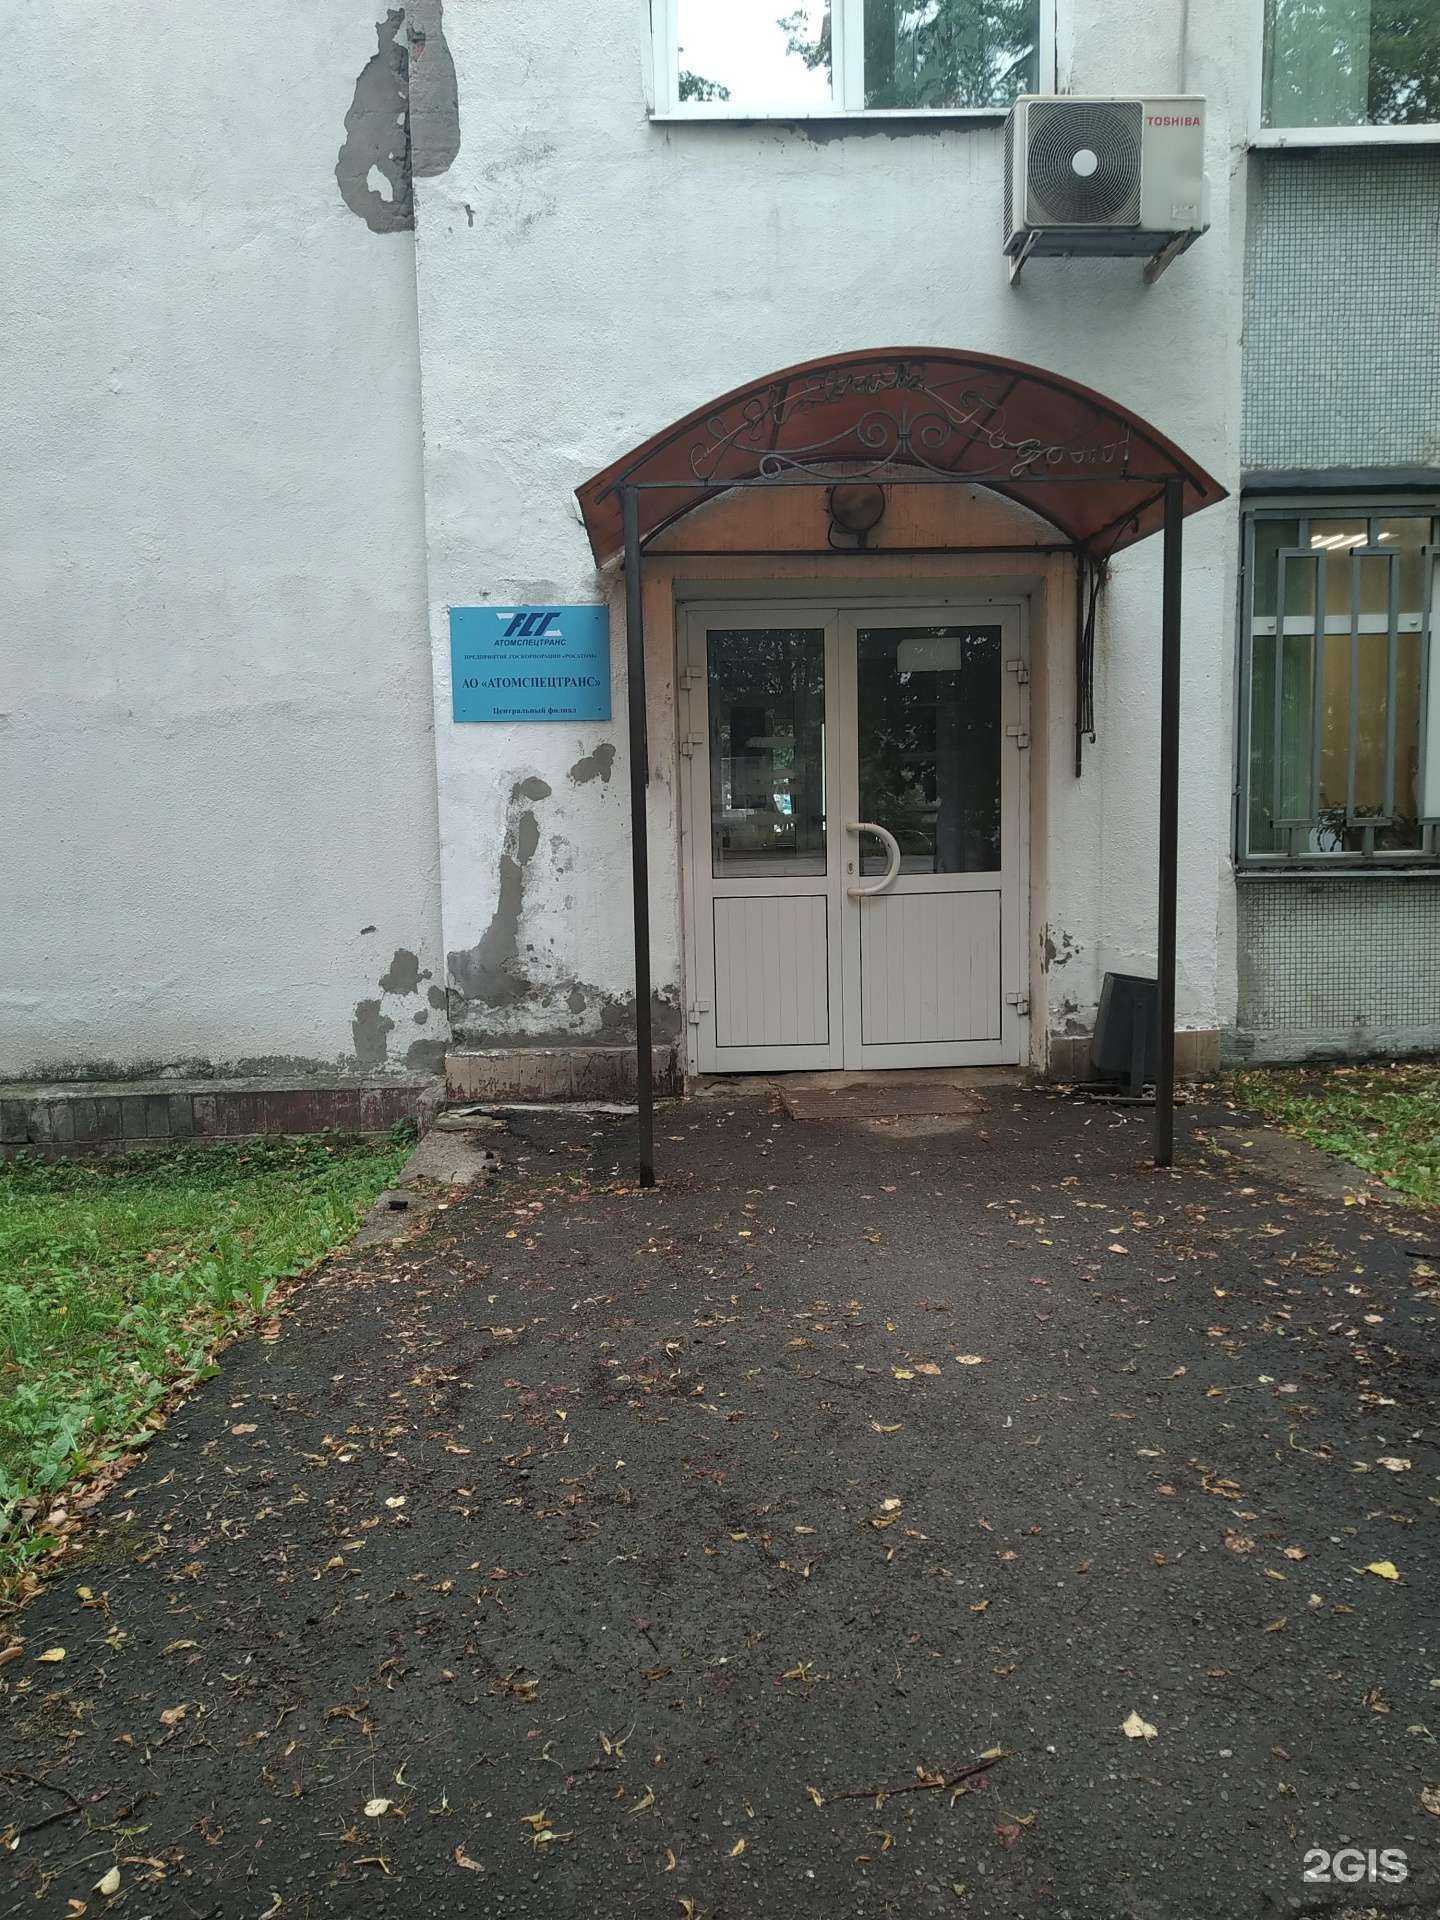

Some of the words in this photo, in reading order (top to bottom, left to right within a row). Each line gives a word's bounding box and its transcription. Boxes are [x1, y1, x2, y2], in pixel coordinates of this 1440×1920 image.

[1147, 116, 1201, 127] TOSHIBA
[494, 639, 567, 647] АТОМСПЕЦТРАНС
[462, 678, 479, 689] АО
[481, 676, 601, 689] «АТОМСПЕЦТРАНС»
[492, 706, 546, 715] Центральный
[547, 706, 577, 715] филиал
